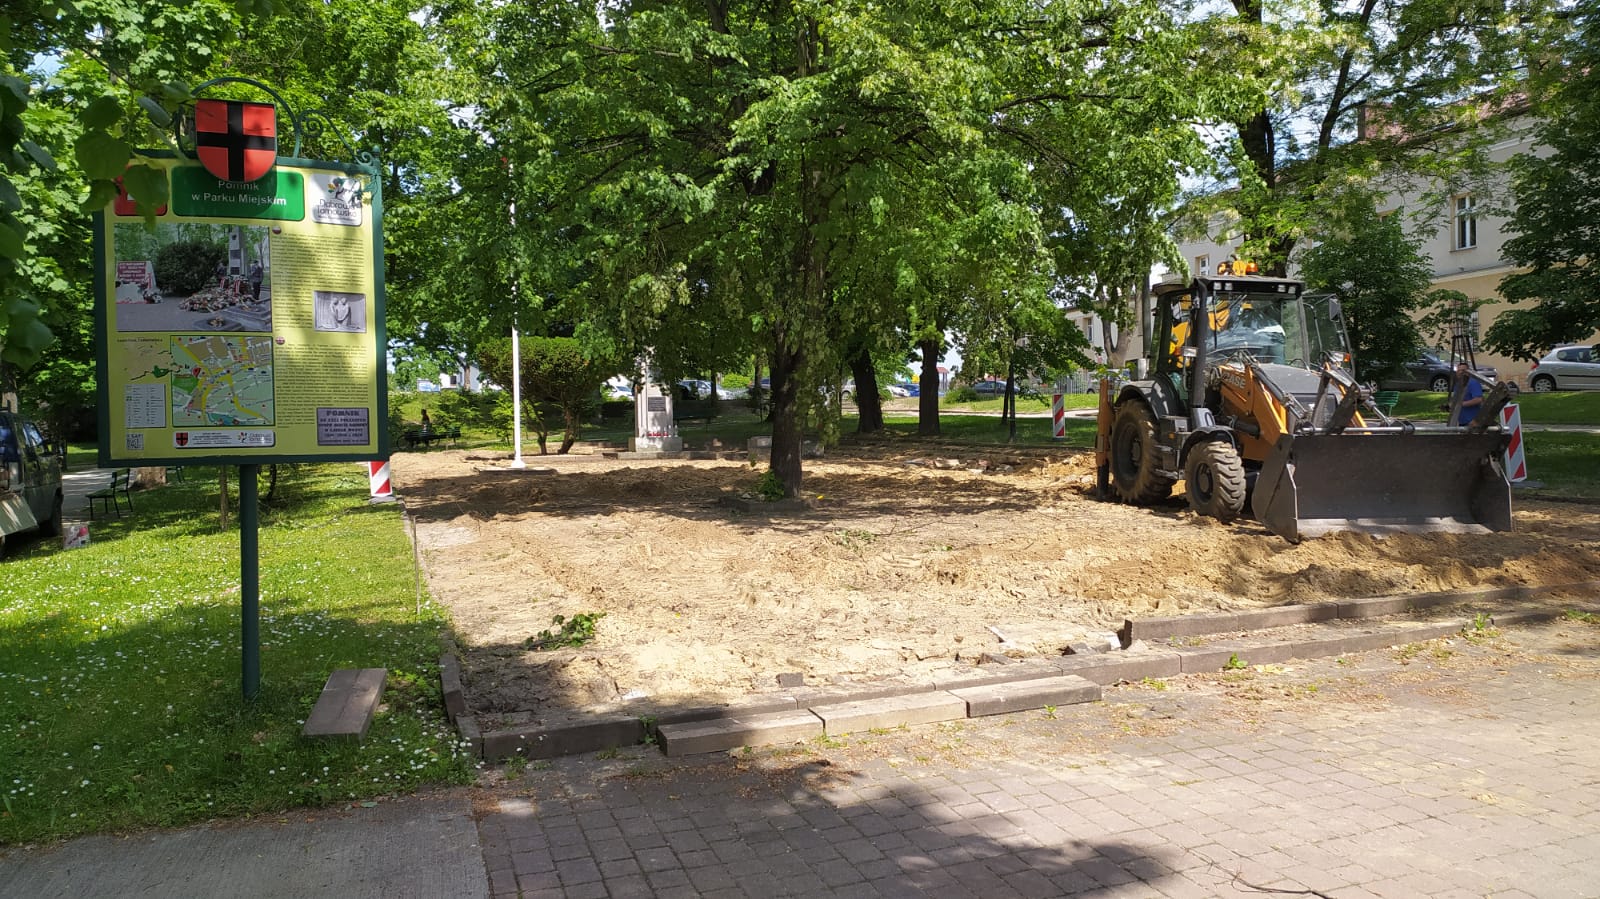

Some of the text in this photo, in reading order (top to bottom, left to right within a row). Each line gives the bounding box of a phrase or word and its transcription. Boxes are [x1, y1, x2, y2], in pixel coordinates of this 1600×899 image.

[218, 180, 259, 190] Pomnik
[203, 192, 235, 202] Parku
[238, 194, 287, 206] Miejskim
[1221, 371, 1246, 389] CASE
